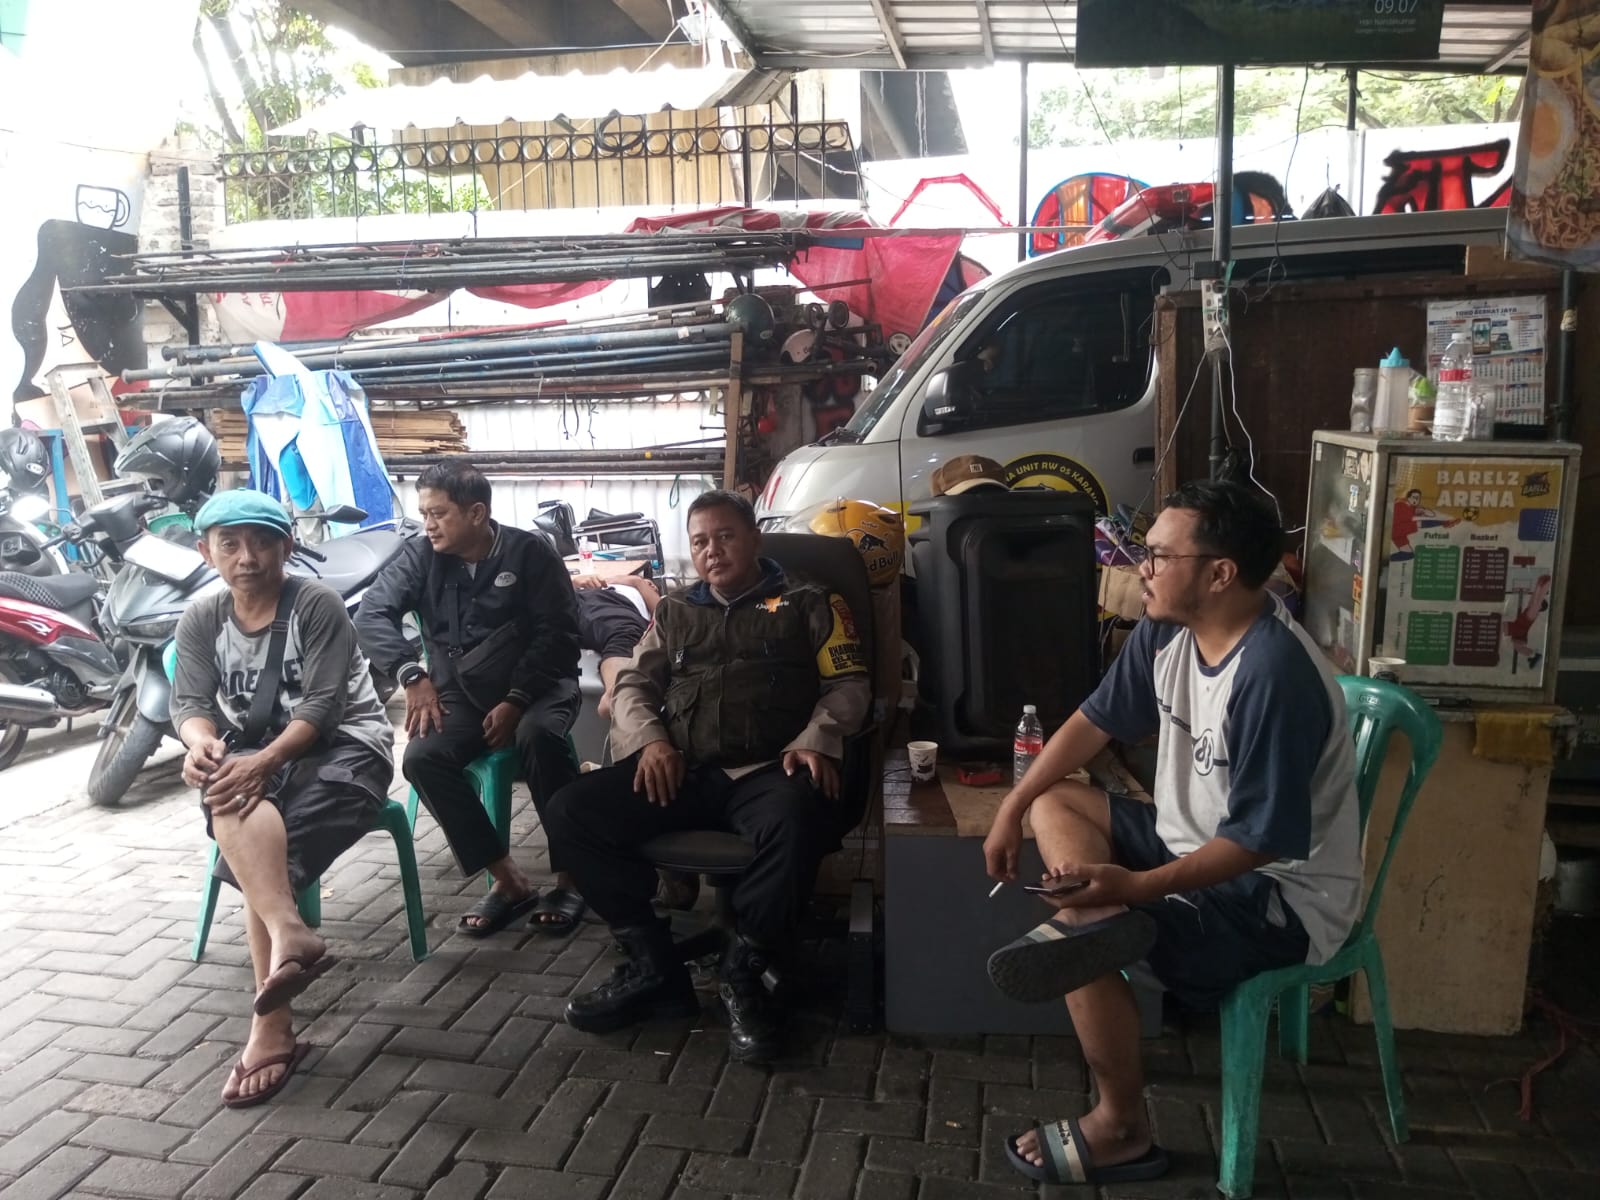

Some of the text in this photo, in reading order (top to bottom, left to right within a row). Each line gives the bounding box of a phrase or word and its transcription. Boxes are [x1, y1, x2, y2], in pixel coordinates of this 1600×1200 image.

[1016, 462, 1040, 475] UNIT
[1041, 461, 1058, 471] RW
[1437, 470, 1520, 485] BARELZ
[1437, 490, 1515, 507] ARENA
